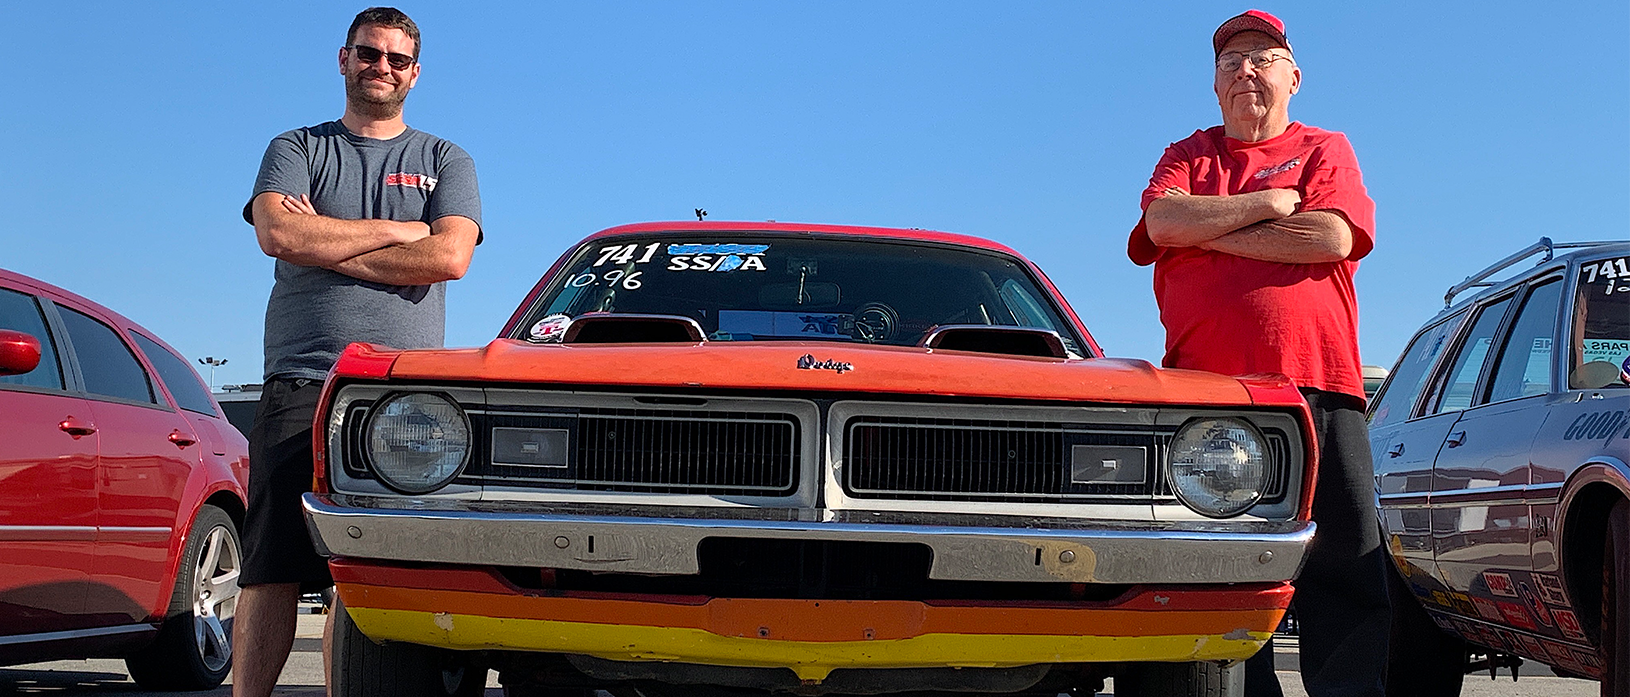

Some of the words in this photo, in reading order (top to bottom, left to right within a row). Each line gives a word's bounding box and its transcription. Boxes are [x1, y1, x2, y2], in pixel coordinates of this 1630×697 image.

[593, 243, 661, 267] 741
[667, 254, 767, 273] SS/A
[563, 270, 643, 290] 10.96
[1582, 258, 1630, 284] 741
[797, 353, 854, 374] Dodge
[1553, 610, 1580, 633] MSD
